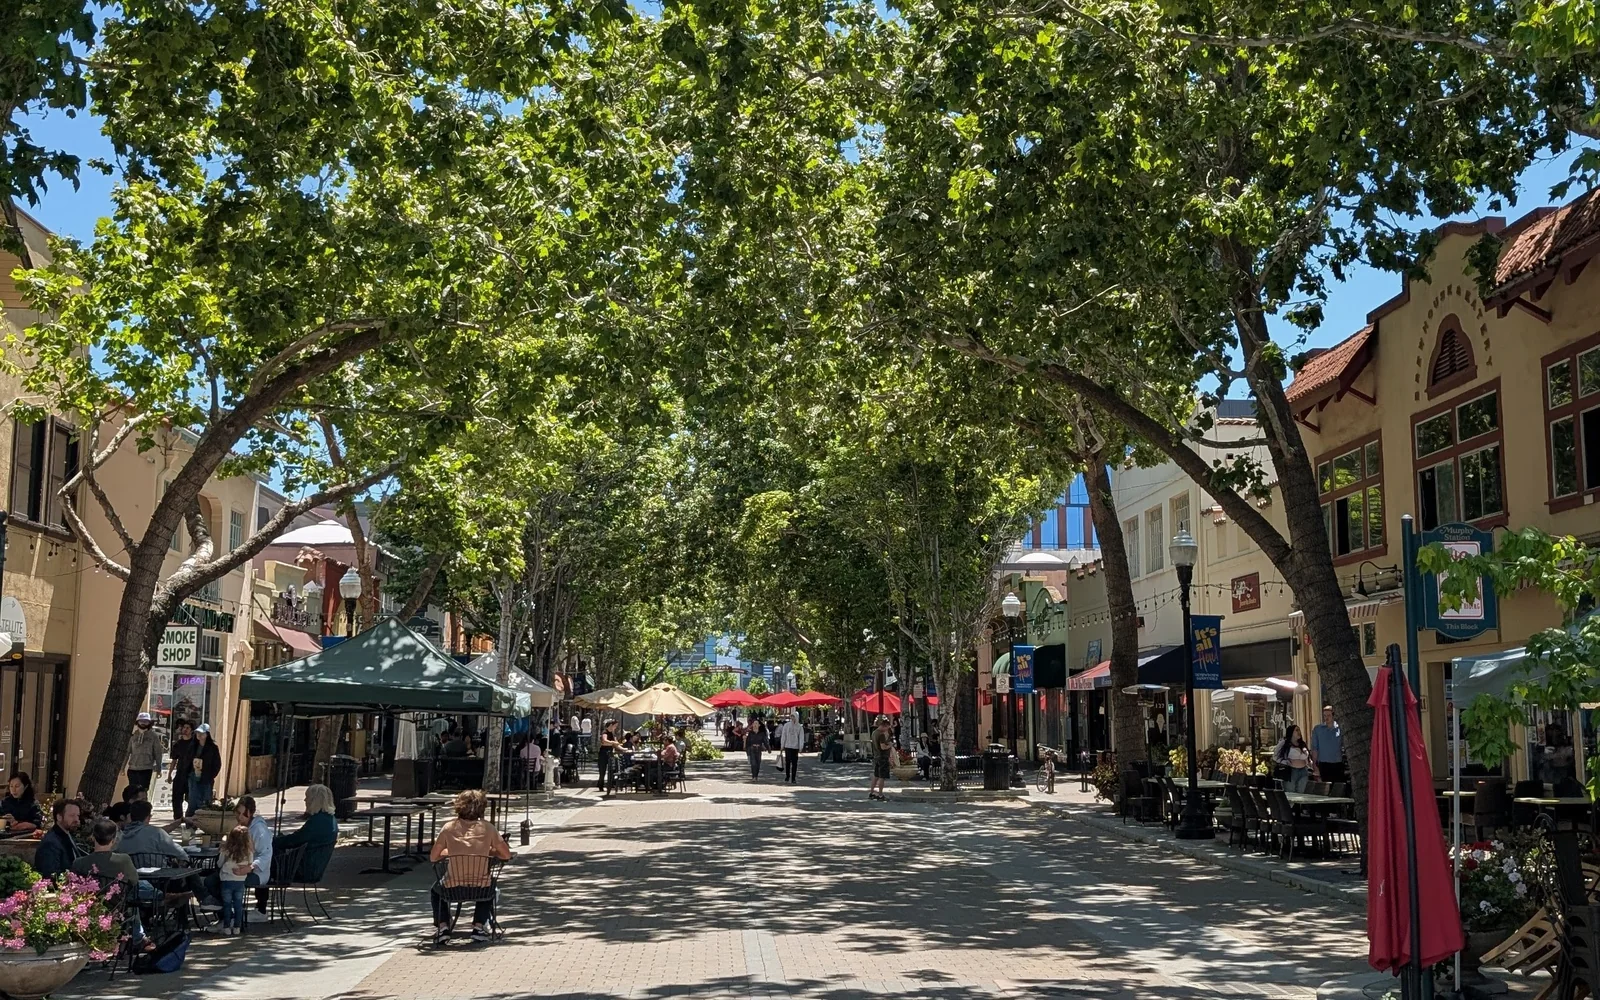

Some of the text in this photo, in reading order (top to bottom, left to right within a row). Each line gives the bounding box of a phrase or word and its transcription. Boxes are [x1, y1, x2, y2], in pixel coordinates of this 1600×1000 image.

[1440, 527, 1474, 536] Murphy
[0, 619, 23, 634] TELLITE
[160, 630, 196, 645] SMOKE
[1194, 627, 1217, 641] It's
[1196, 637, 1213, 652] all
[162, 648, 192, 662] SHOP
